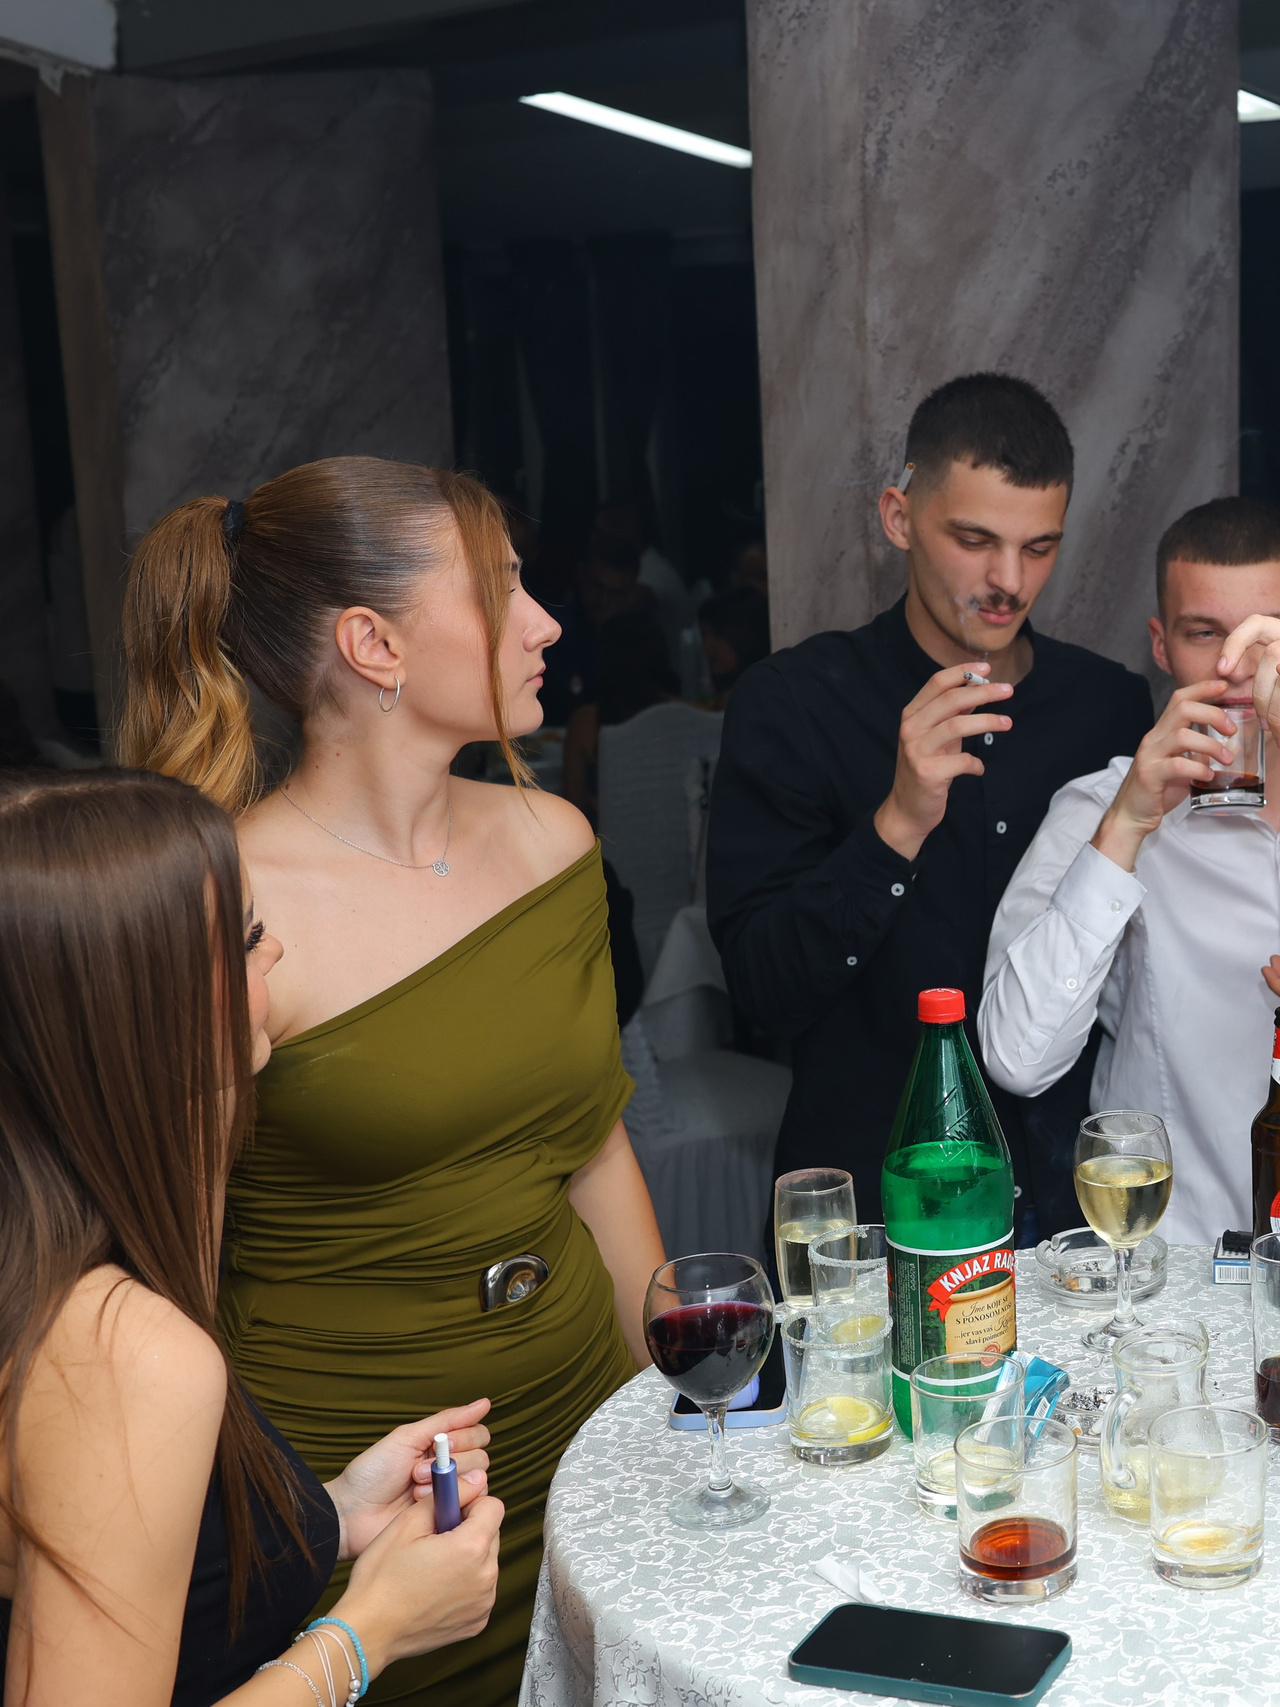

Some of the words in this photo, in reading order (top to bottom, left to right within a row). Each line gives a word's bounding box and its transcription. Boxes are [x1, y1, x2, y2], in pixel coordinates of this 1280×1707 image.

[939, 1254, 991, 1293] KNJAZ
[961, 1301, 985, 1317] Ime
[962, 1308, 1000, 1325] PONOSOM
[965, 1337, 981, 1346] slavi
